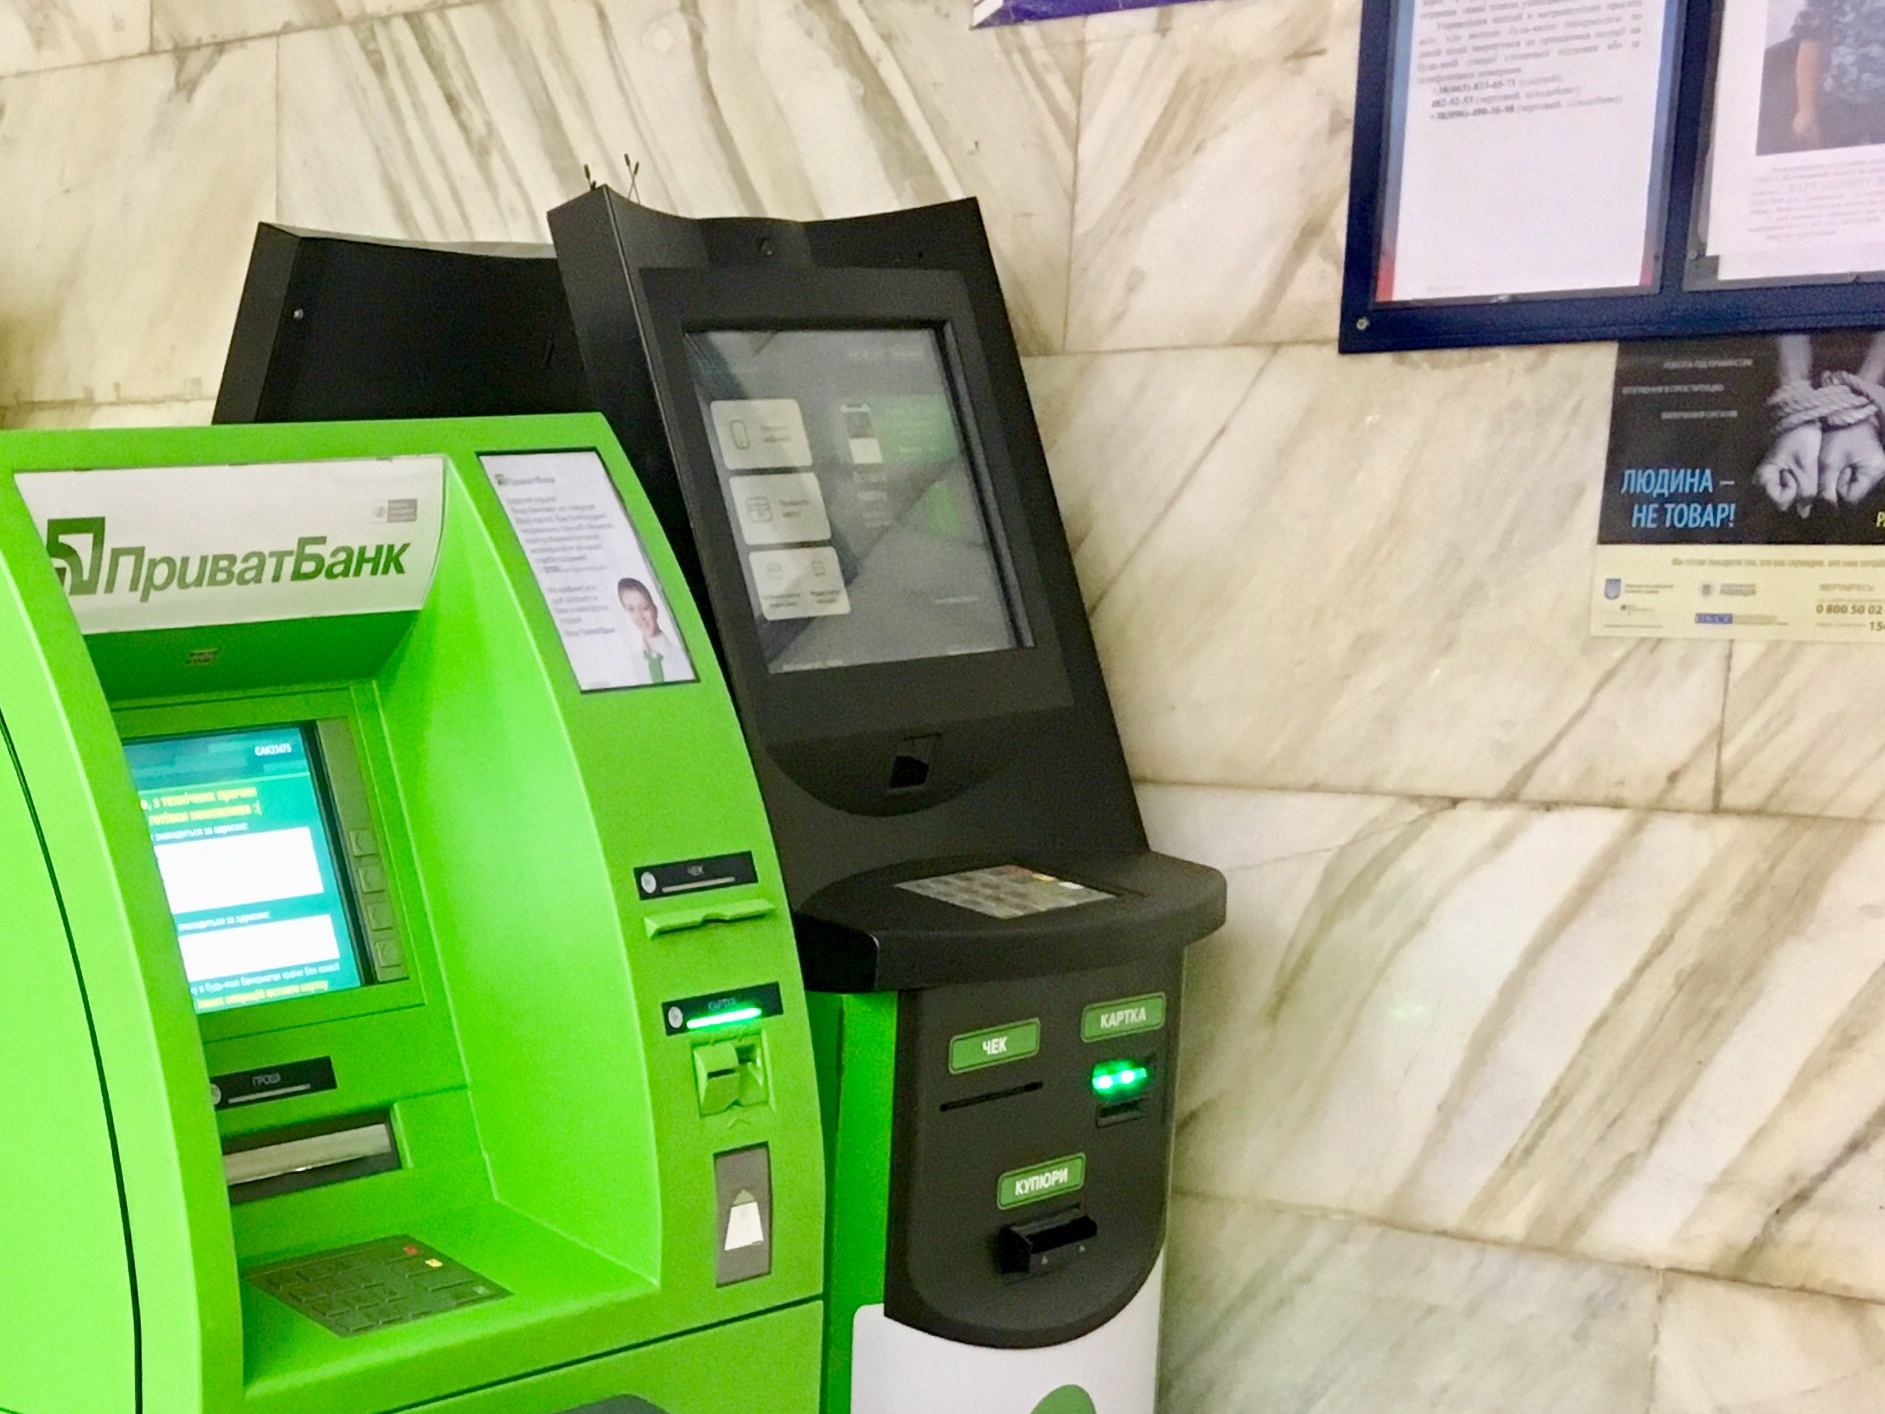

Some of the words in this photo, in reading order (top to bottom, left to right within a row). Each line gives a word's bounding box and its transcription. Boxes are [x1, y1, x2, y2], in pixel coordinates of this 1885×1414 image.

[1620, 469, 1713, 497] ЛЮДИНА
[1631, 505, 1658, 528] НЕ
[1664, 503, 1736, 528] ТОВАР!
[104, 536, 410, 602] ПриватБанк
[1816, 604, 1824, 614] 0
[1826, 604, 1848, 614] 800
[1851, 605, 1865, 614] 50
[1868, 605, 1883, 615] 02
[1100, 1007, 1146, 1029] КАРТКА
[982, 1036, 1007, 1055] ЧЕК
[1014, 1168, 1068, 1196] КУПЮРИ
